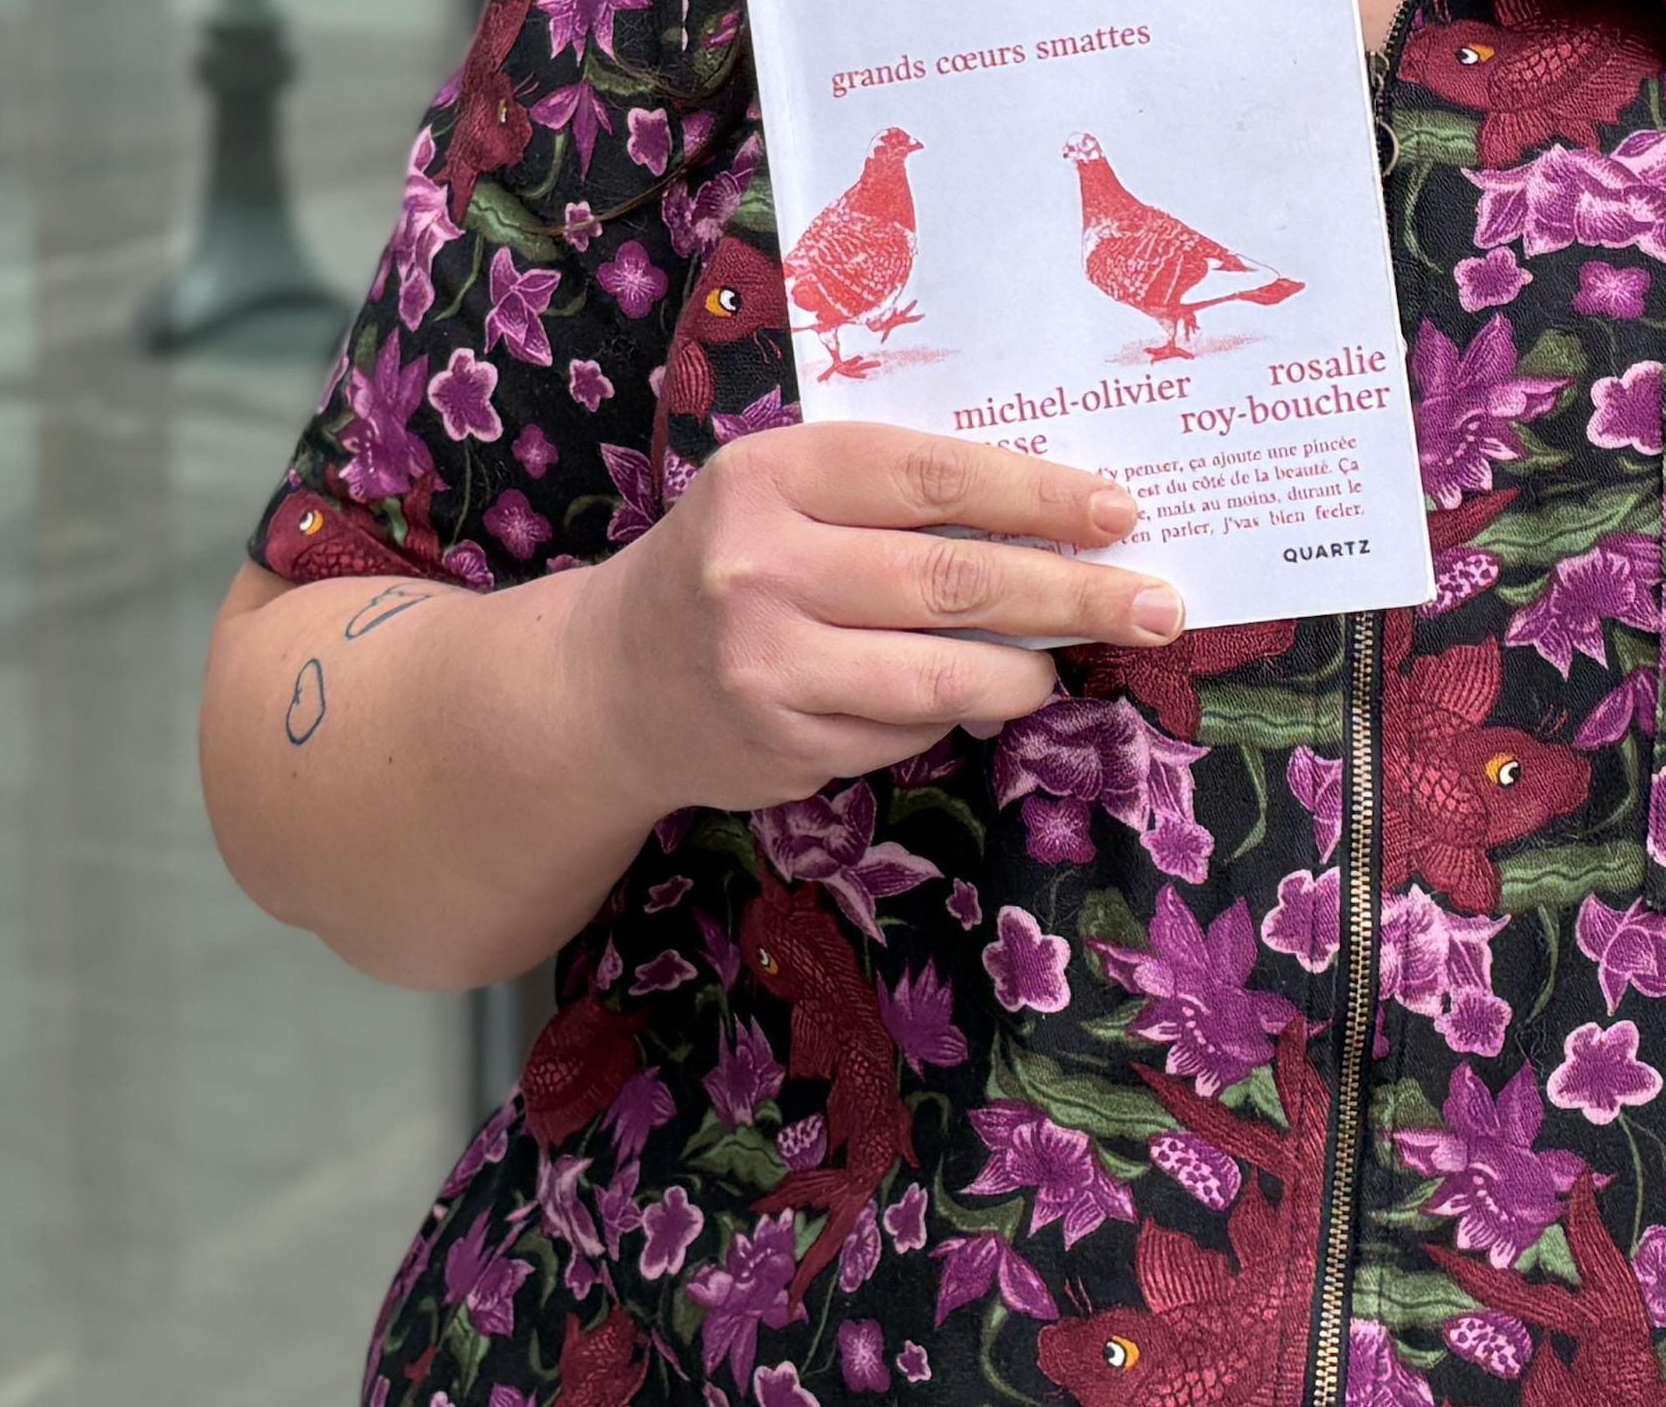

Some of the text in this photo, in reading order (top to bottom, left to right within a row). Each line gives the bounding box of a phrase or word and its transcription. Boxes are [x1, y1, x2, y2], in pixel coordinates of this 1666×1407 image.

[831, 24, 1151, 99] grands cœurs smattes
[1268, 346, 1388, 387] rosalie
[952, 373, 1192, 431] michel-olivier
[1180, 384, 1392, 438] roy-boucher
[1212, 450, 1262, 469] ajoute
[1267, 445, 1298, 460] une
[1302, 435, 1358, 459] pincée
[1137, 483, 1161, 498] est
[1166, 478, 1187, 495] du
[1191, 473, 1226, 491] côté
[1230, 470, 1250, 487] de
[1254, 468, 1270, 483] la
[1156, 499, 1196, 518] mais
[1201, 499, 1221, 513] au
[1287, 485, 1342, 501] durant
[1347, 478, 1362, 494] le
[1268, 509, 1306, 526] bien
[1282, 539, 1371, 564] QUARTZ
